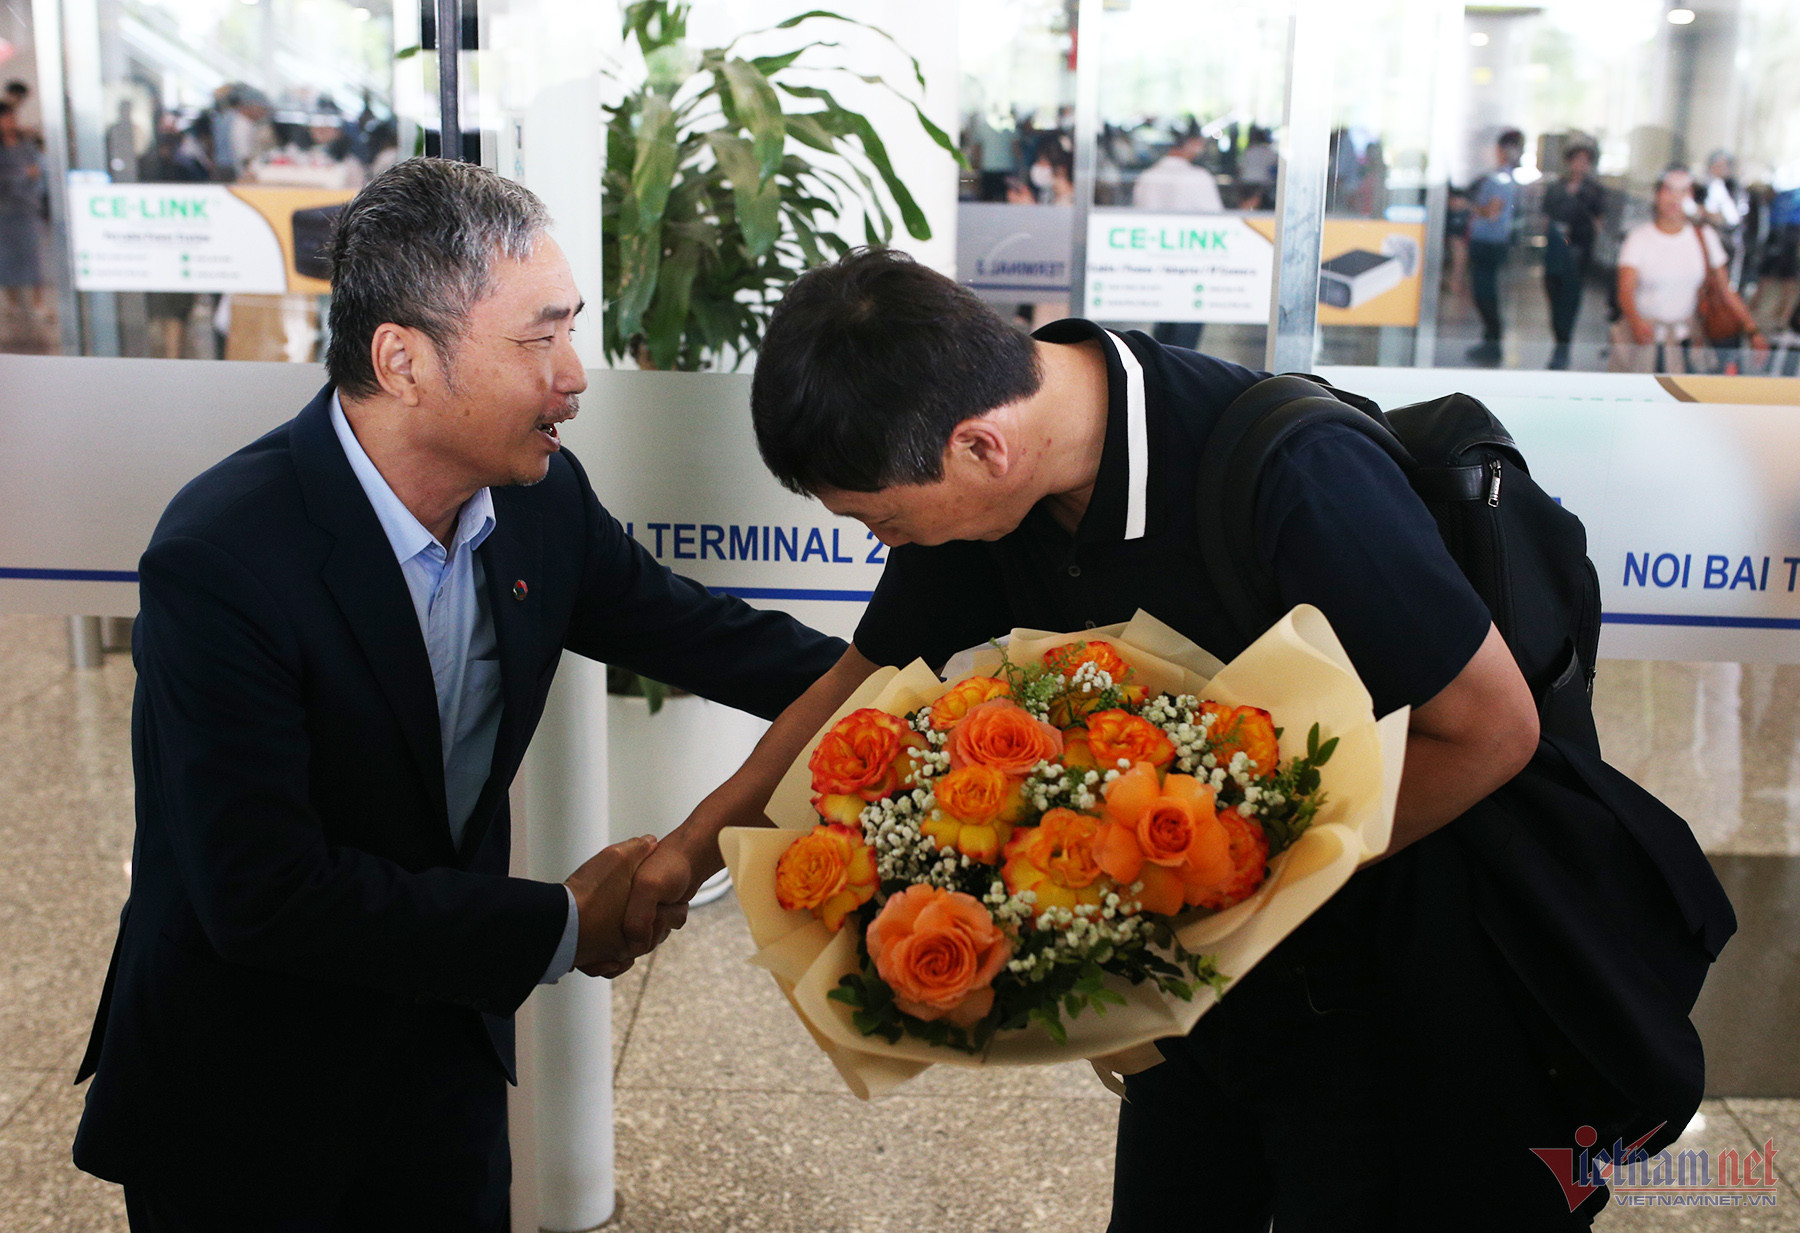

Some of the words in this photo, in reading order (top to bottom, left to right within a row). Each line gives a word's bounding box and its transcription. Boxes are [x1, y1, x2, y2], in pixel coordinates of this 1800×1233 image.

[89, 196, 209, 219] CE-LINK
[1108, 227, 1228, 250] CE-LINK
[647, 523, 853, 563] TERMINAL
[865, 531, 885, 564] 2
[1623, 552, 1692, 588] NOI
[1703, 555, 1770, 591] BAI
